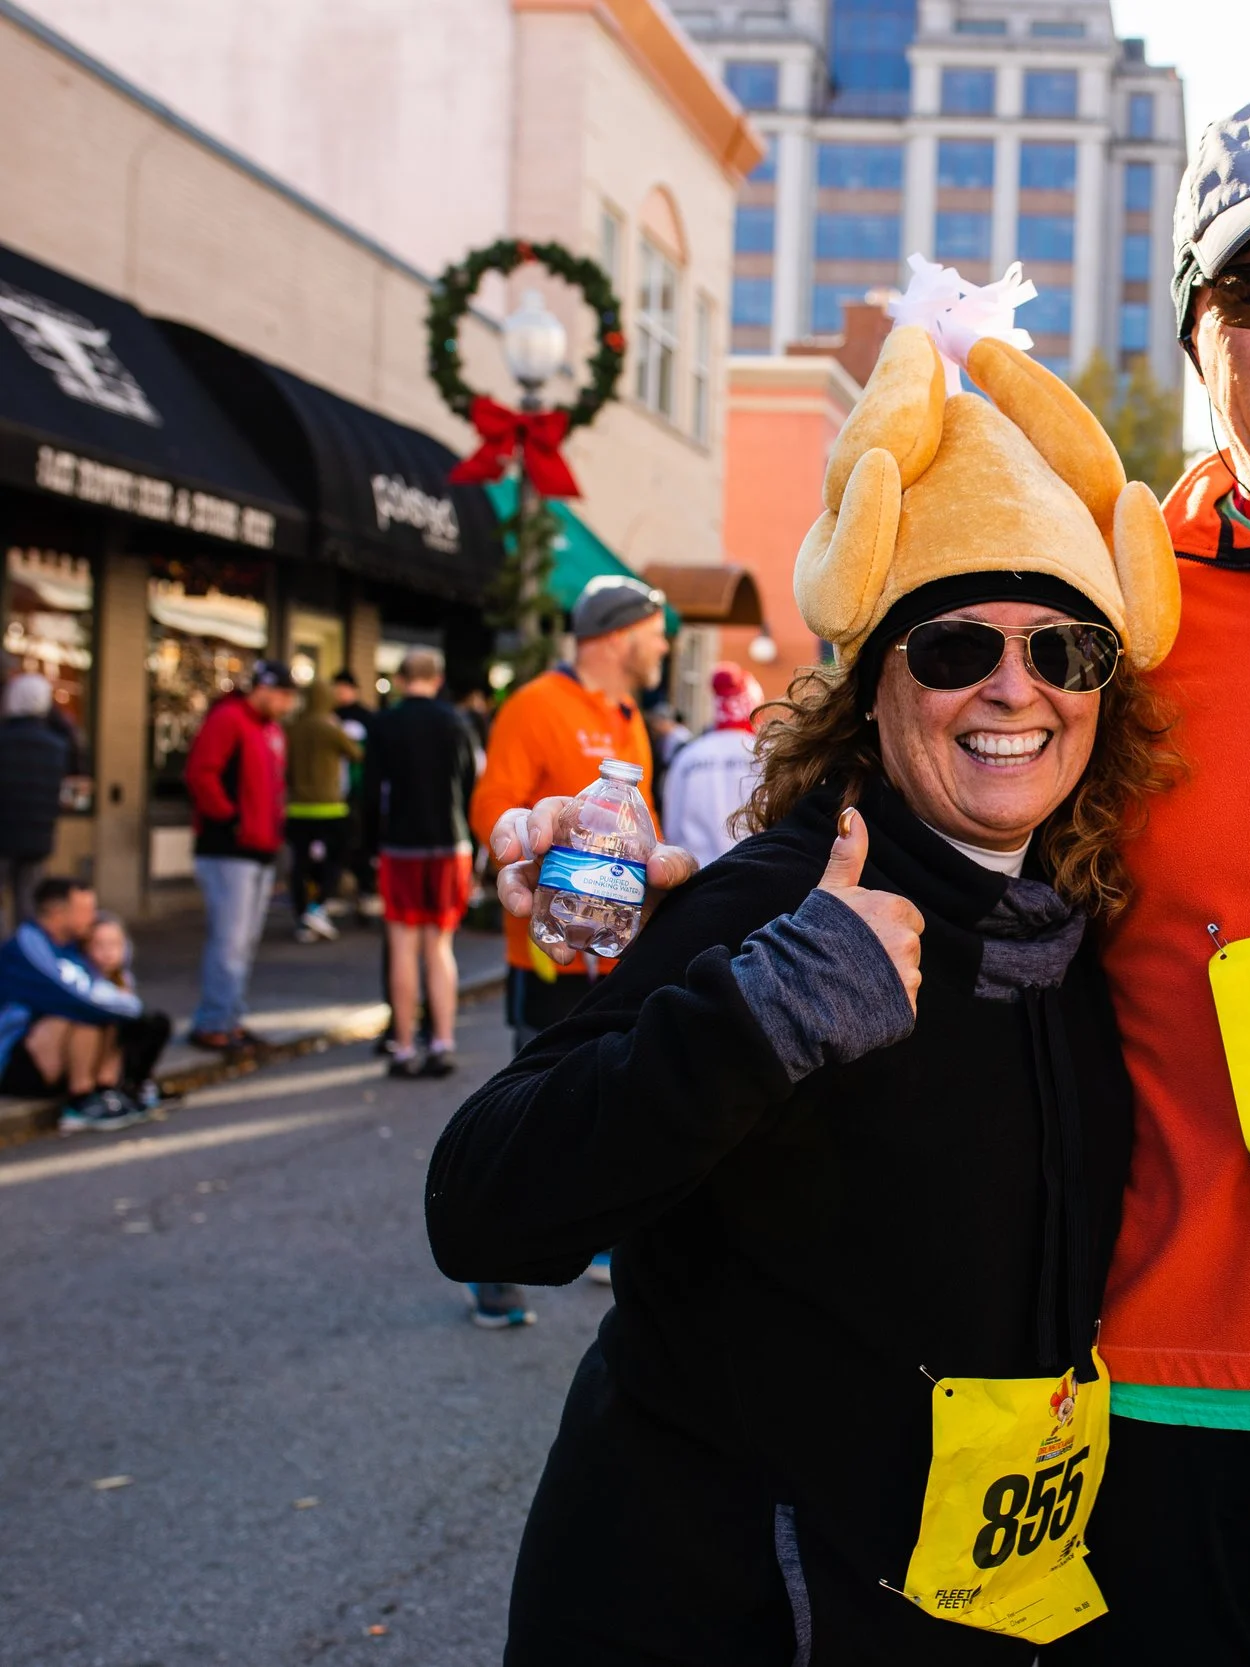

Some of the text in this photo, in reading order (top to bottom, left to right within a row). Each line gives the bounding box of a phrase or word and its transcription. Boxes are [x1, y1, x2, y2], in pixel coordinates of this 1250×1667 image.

[583, 877, 618, 890] DRINKING
[620, 885, 639, 894] WATER
[972, 1445, 1090, 1570] 855
[935, 1589, 973, 1599] FLEET
[937, 1599, 969, 1609] FEET
